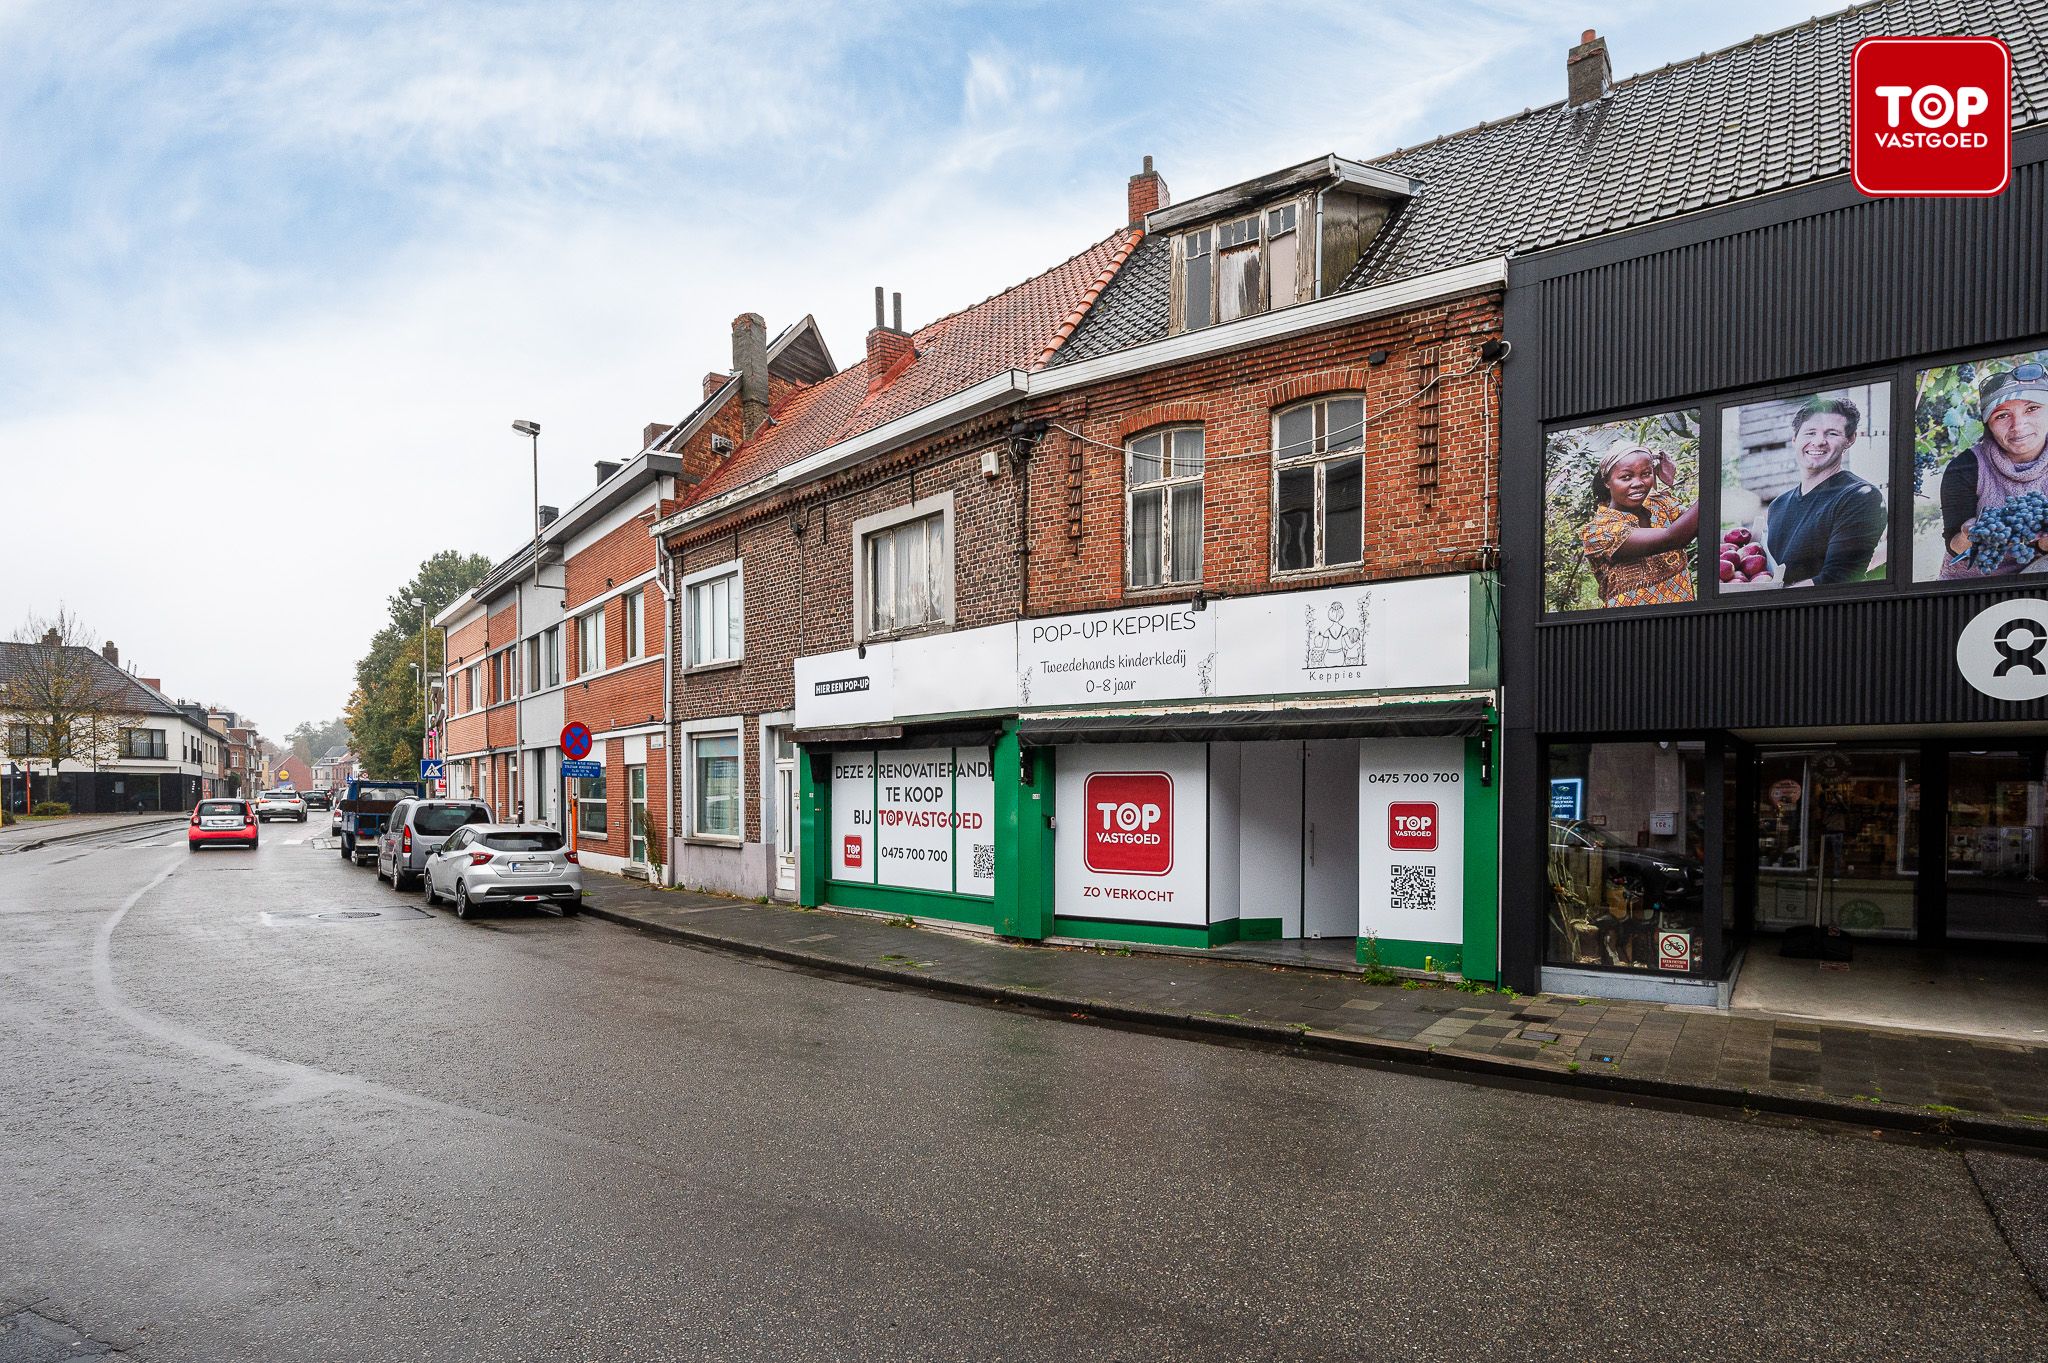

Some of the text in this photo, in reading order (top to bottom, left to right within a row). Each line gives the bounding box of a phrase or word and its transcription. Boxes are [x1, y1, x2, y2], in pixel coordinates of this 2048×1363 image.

[1033, 611, 1196, 643] POP-UP KEPPIES
[1040, 649, 1186, 674] Tweedehands kinderkledij
[1309, 671, 1361, 683] Keppies
[815, 678, 870, 695] HIER EEN POP-UP
[1113, 678, 1137, 695] jaar
[835, 765, 864, 779] DEZE
[867, 765, 874, 779] 2
[1368, 773, 1460, 783] 0475 700 700
[885, 787, 944, 802] TE KOOP
[853, 809, 872, 825] BIJ
[1096, 802, 1161, 831] TOP
[1395, 816, 1432, 831] TOP
[1096, 832, 1161, 845] VASTGOED
[846, 844, 861, 854] TOP
[881, 846, 948, 862] 0475 700 700
[1083, 886, 1174, 902] ZO VERKOCHT
